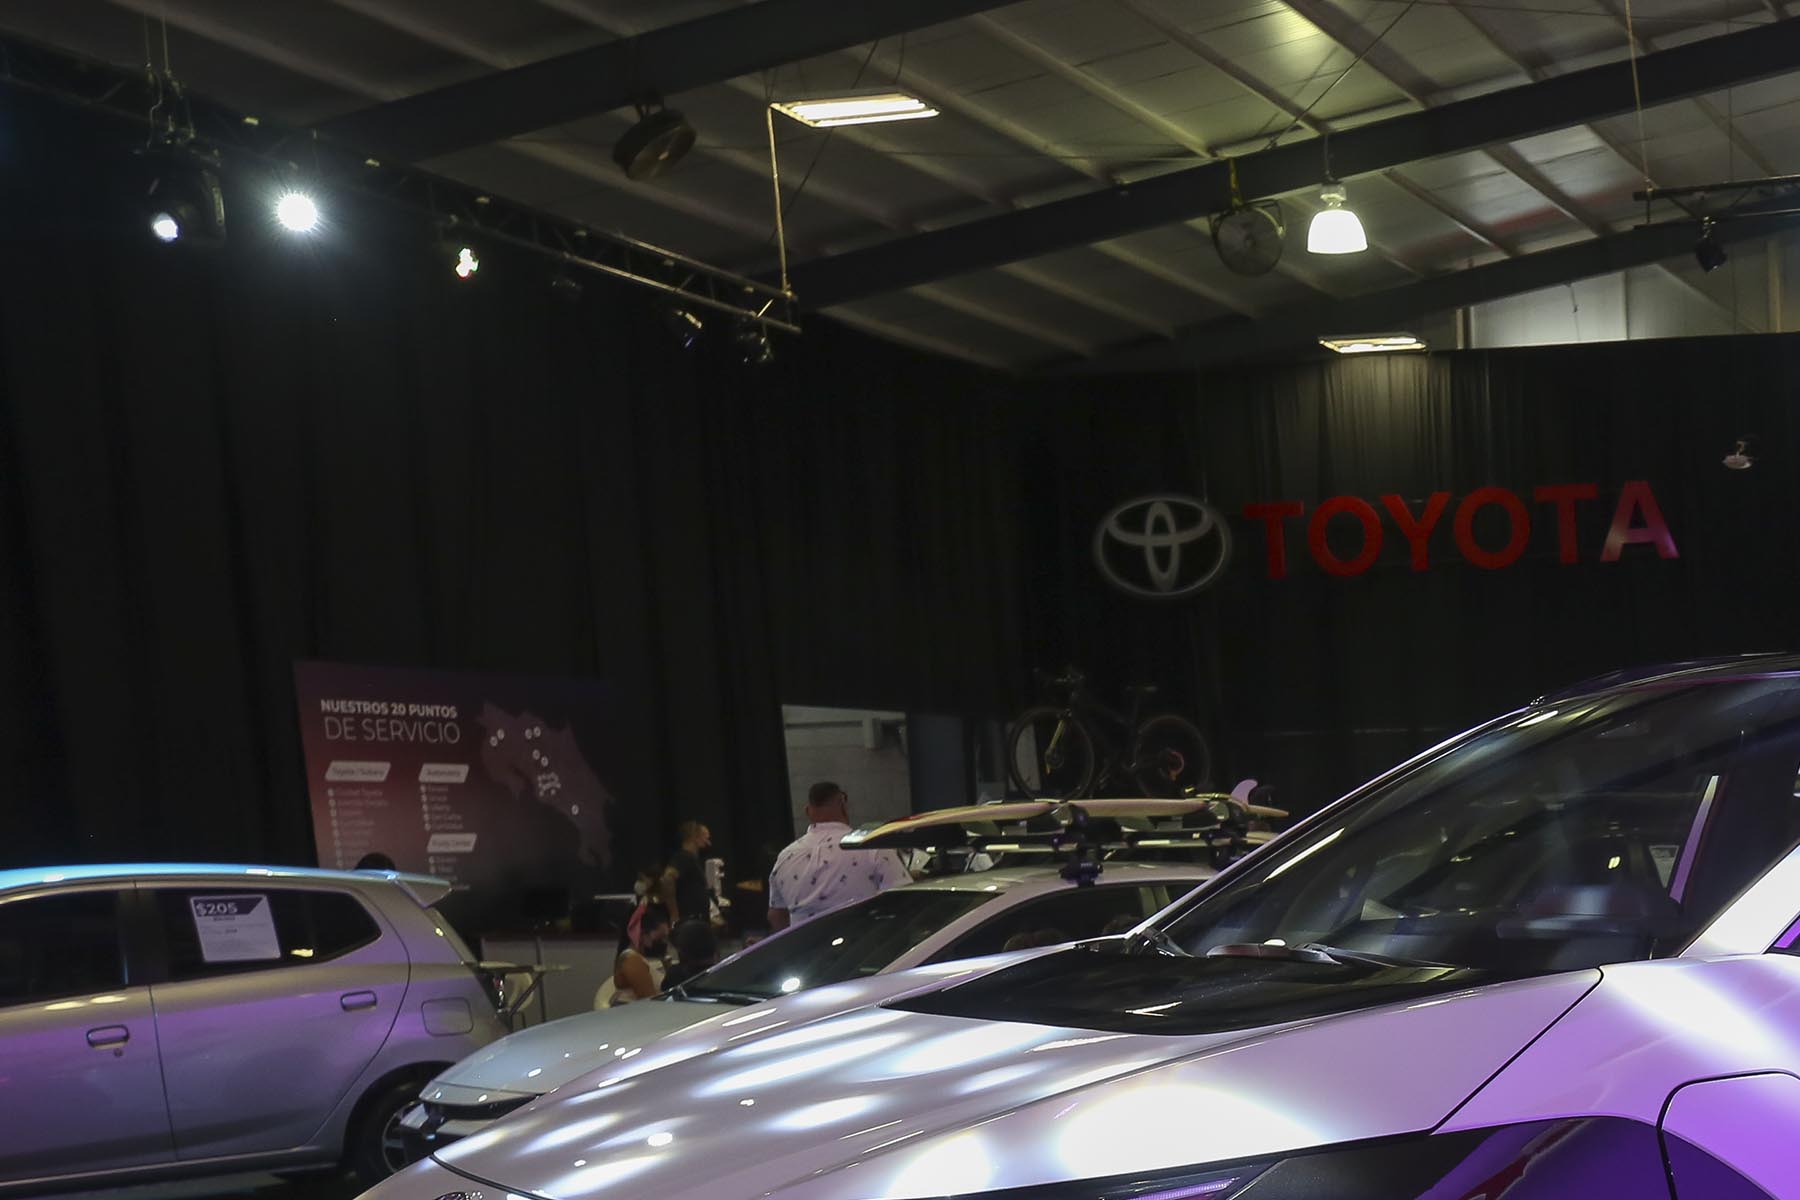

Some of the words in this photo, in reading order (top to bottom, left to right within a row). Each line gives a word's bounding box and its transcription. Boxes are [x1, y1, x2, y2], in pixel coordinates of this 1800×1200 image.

[1242, 479, 1681, 581] TOYOTA
[320, 699, 389, 716] NUESTROS
[390, 702, 406, 717] 20
[409, 704, 458, 719] PUNTOS
[324, 716, 357, 741] DE
[361, 718, 461, 744] SERVICIO
[196, 901, 238, 915] $205
